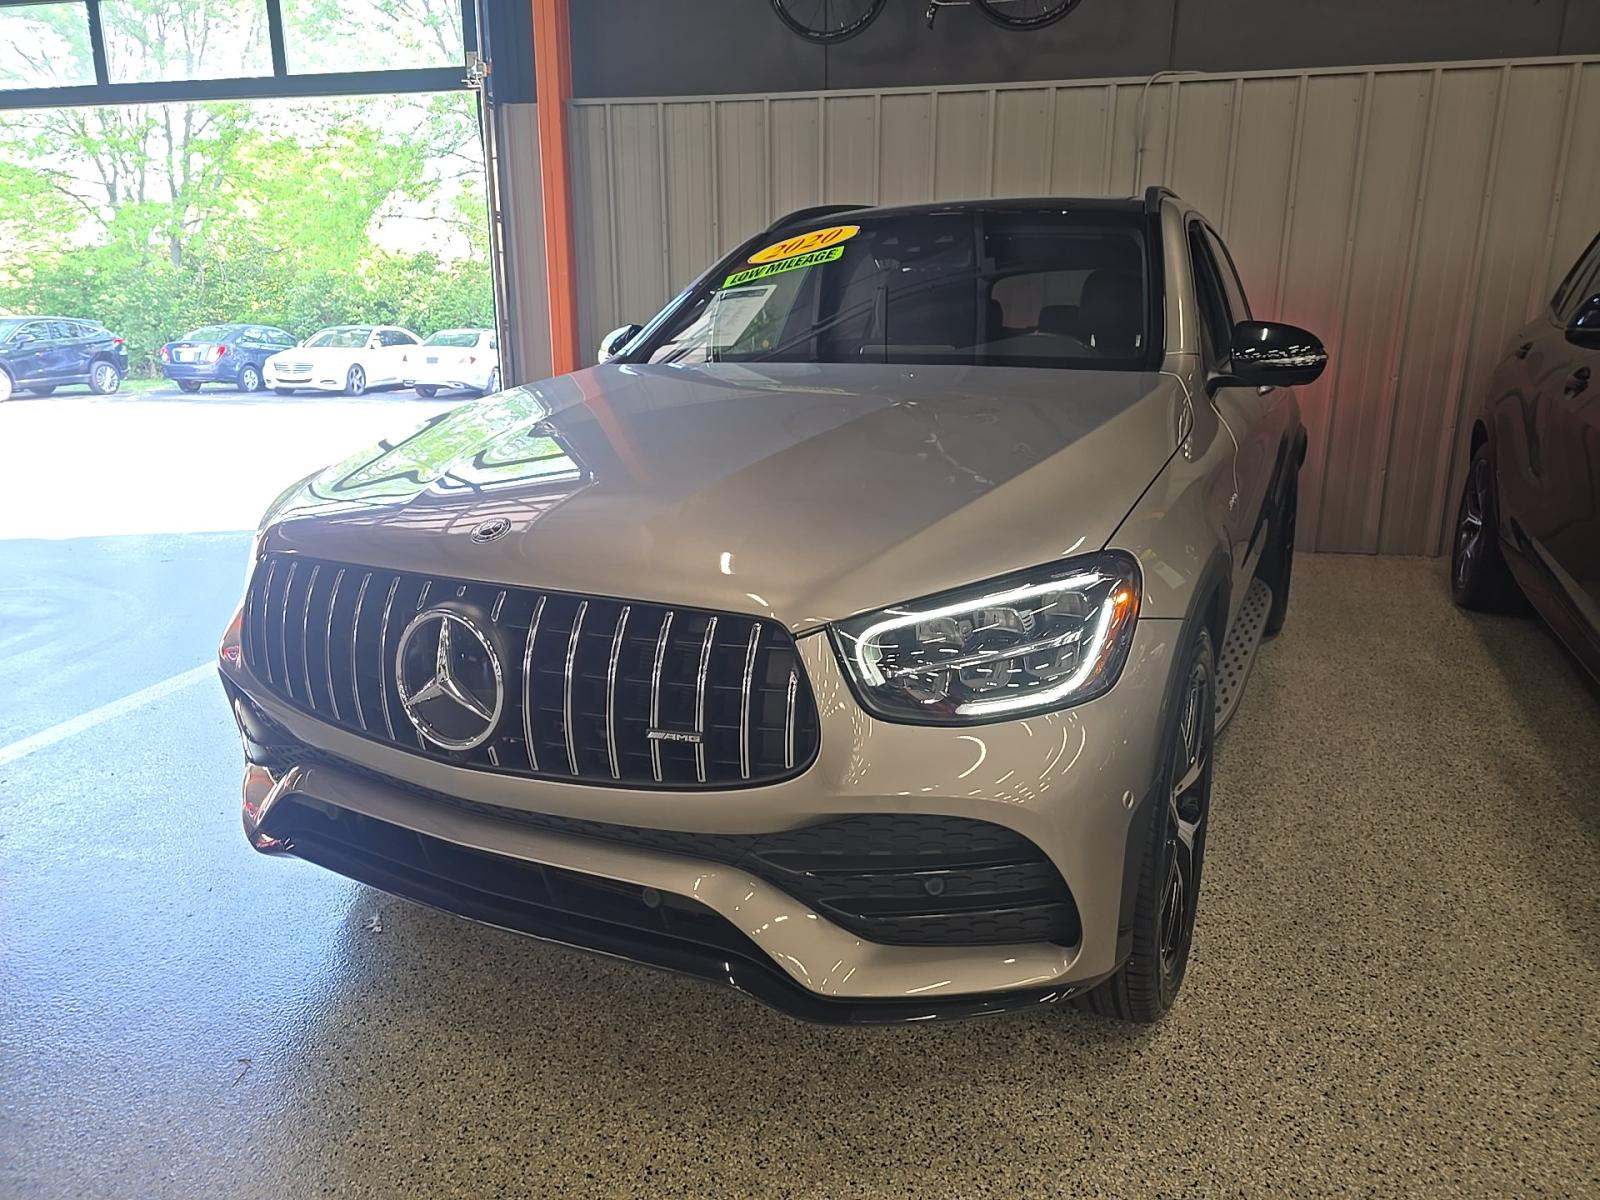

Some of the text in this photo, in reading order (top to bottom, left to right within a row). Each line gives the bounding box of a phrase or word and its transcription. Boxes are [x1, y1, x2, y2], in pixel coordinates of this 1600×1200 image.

[762, 228, 844, 260] 2020
[730, 248, 837, 285] LOW MILEAGE
[663, 732, 700, 743] AMG
